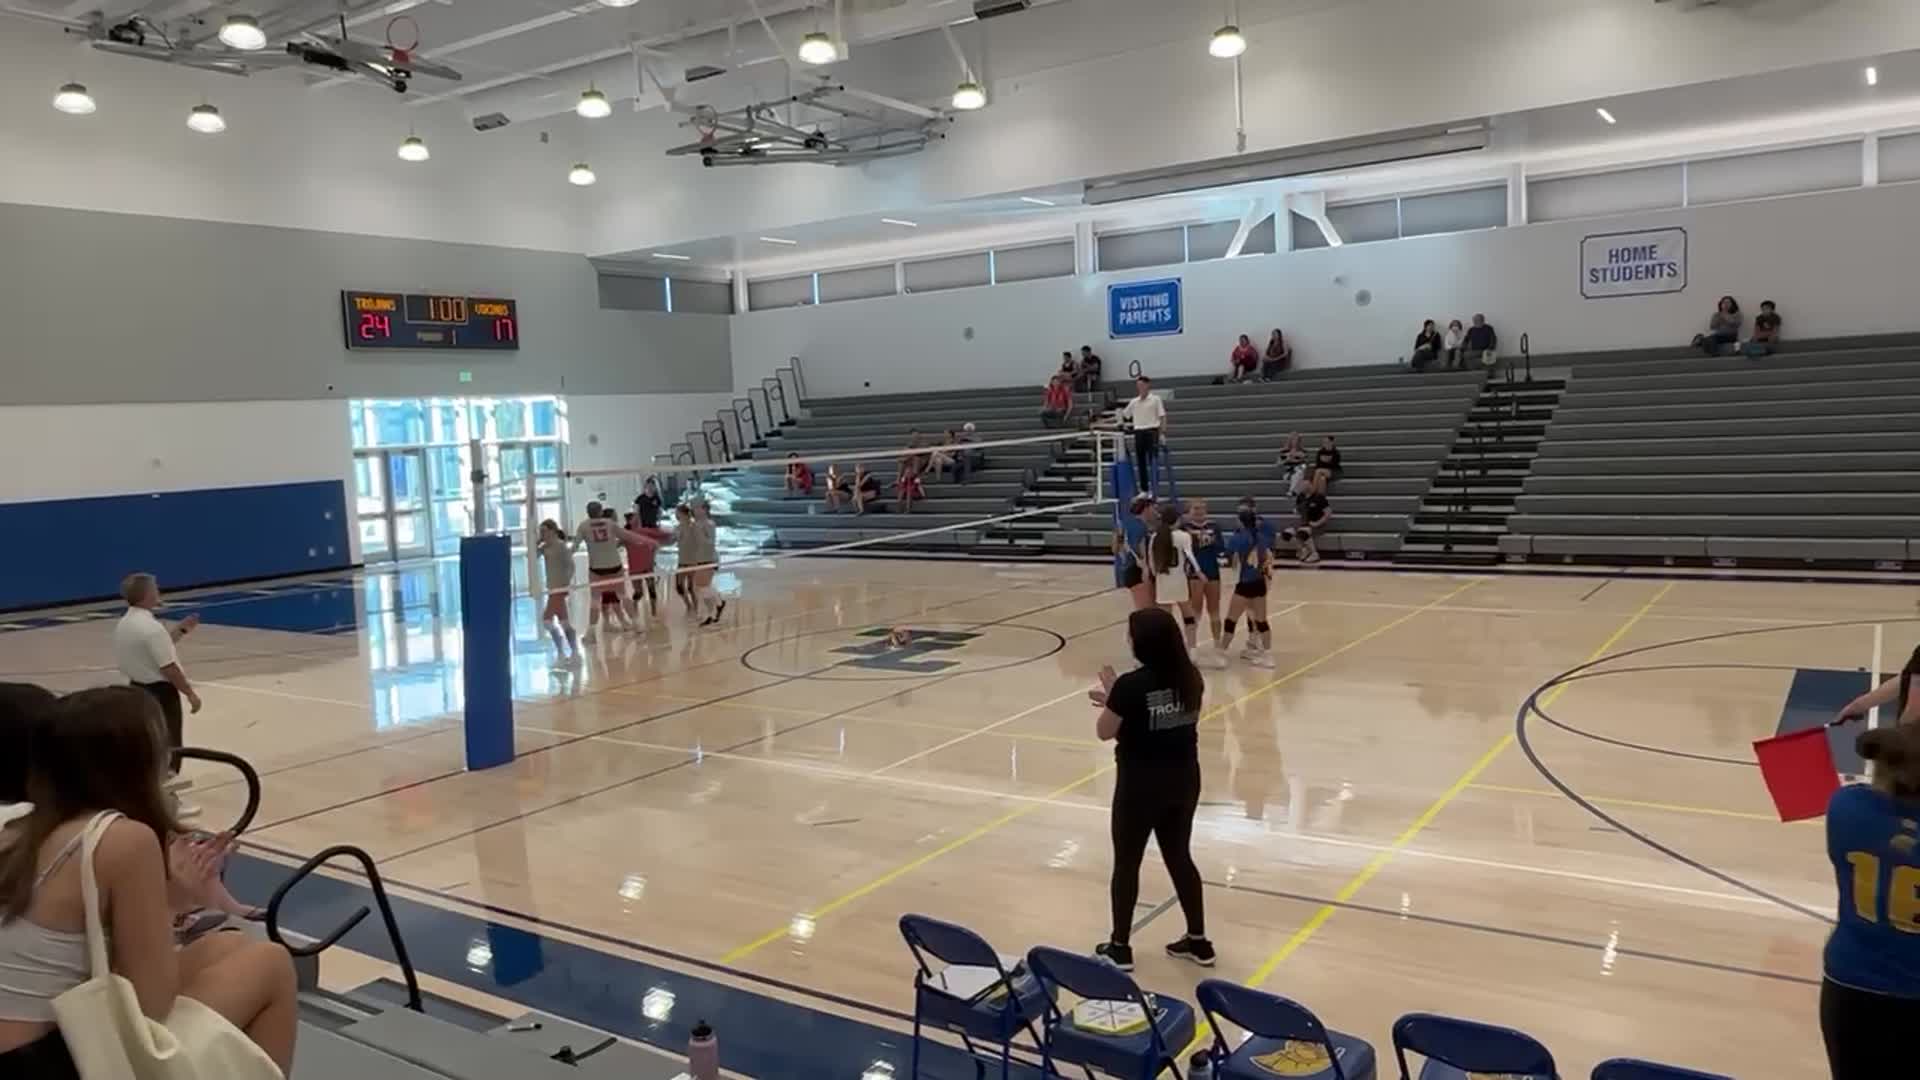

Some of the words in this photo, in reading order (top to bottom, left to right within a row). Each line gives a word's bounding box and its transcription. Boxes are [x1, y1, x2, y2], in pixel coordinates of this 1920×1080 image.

[1608, 244, 1658, 264] HOME
[1589, 262, 1678, 284] STUDENTS
[1120, 293, 1169, 310] VISITING
[361, 313, 391, 339] 24
[1120, 307, 1171, 325] PARENTS
[495, 318, 514, 341] 17
